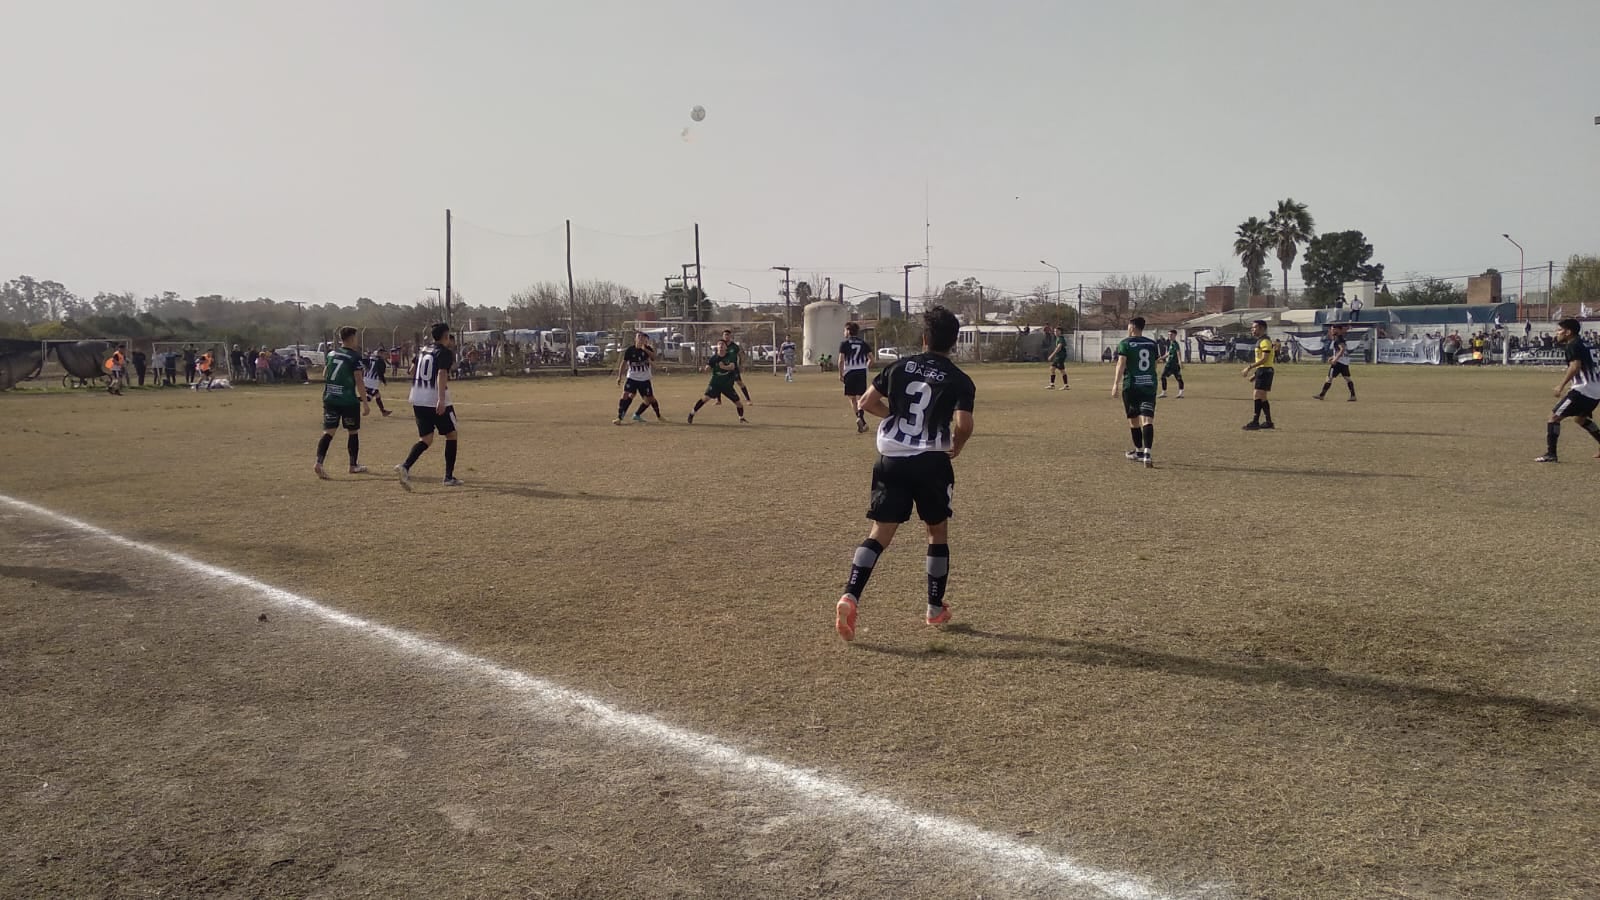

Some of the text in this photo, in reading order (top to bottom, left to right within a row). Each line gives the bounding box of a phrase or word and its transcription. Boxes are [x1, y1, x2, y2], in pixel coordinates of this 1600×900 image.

[851, 344, 861, 360] 7
[1139, 348, 1150, 371] 8
[330, 359, 344, 381] 7
[416, 353, 434, 381] 10
[914, 368, 945, 381] AGRO
[899, 381, 932, 436] 3
